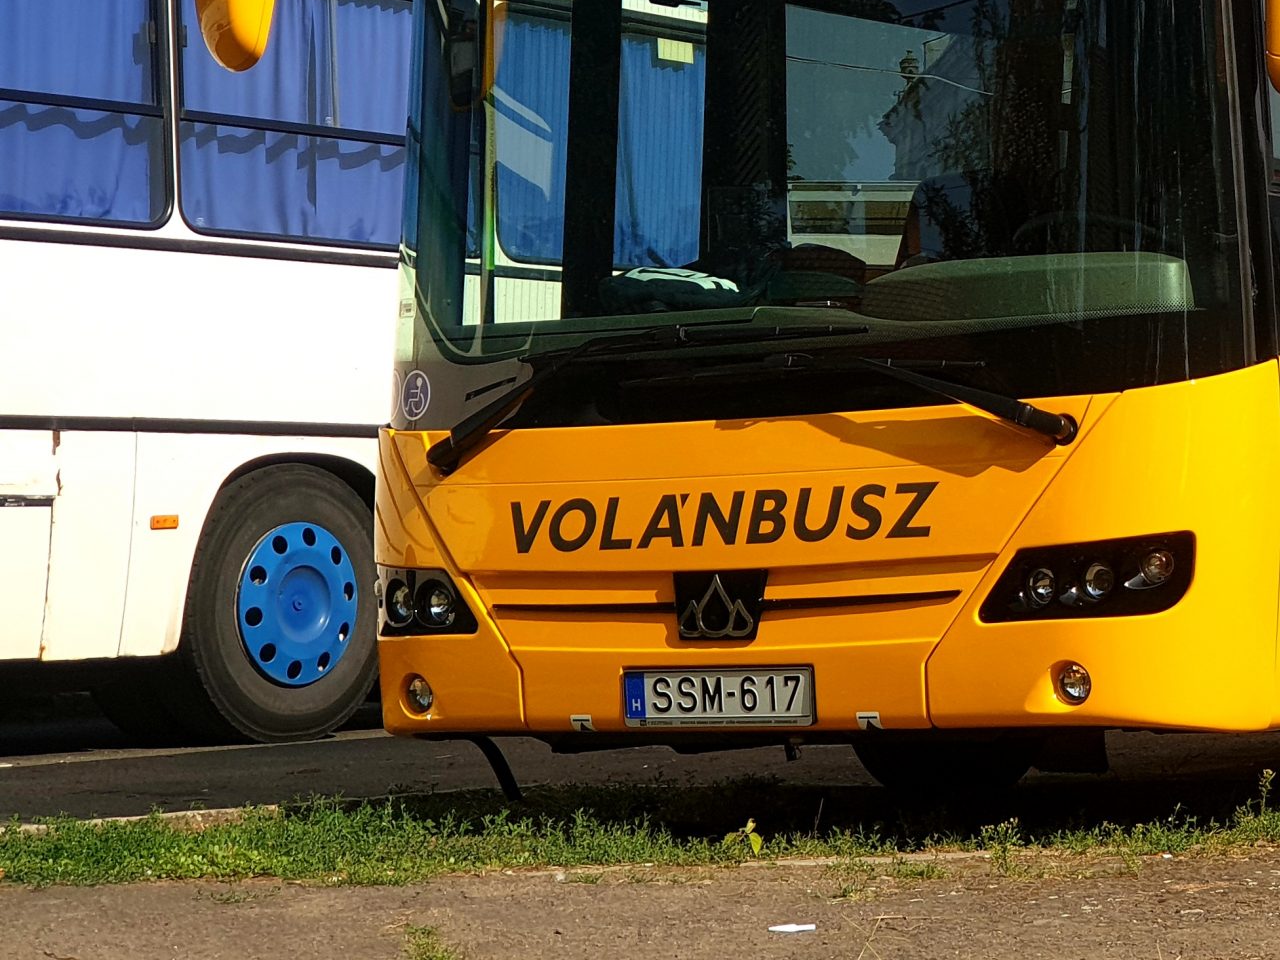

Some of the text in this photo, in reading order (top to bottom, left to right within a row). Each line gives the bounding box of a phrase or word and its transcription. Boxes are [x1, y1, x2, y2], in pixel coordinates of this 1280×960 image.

[510, 481, 940, 554] VOLÁNBUSZ
[632, 698, 641, 711] H
[652, 674, 801, 713] SSM-617
